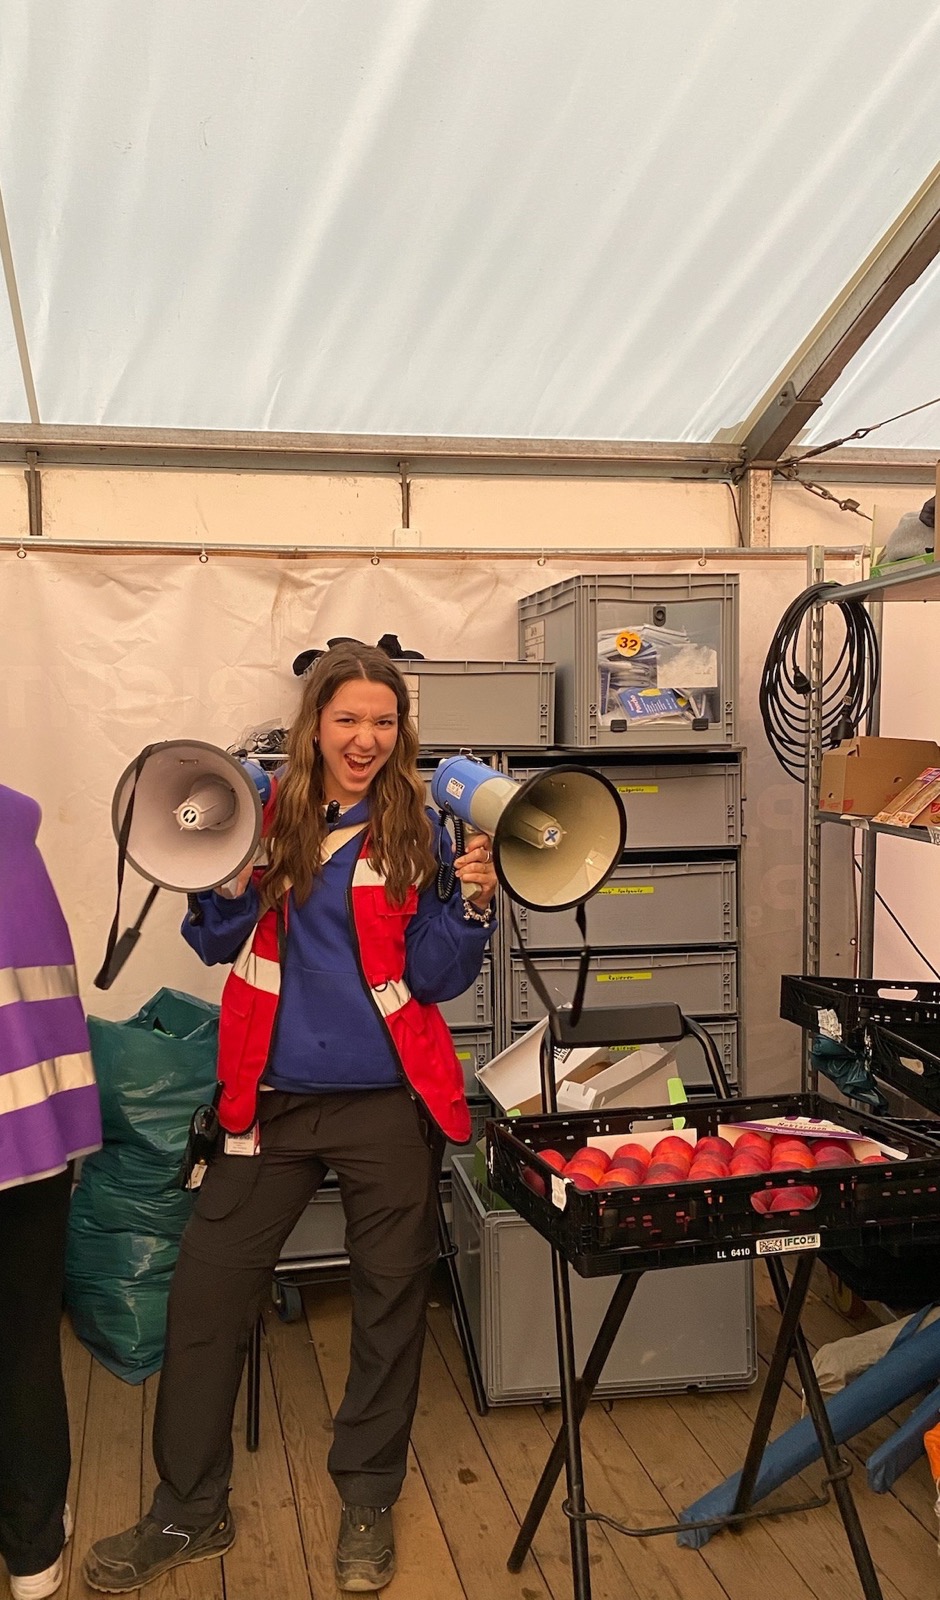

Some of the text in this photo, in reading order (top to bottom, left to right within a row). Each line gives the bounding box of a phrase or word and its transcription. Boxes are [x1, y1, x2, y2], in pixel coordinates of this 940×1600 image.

[618, 636, 638, 651] 32
[777, 1122, 827, 1131] Nektarinen
[784, 1236, 807, 1247] IFCO
[716, 1247, 751, 1259] LL 6410
